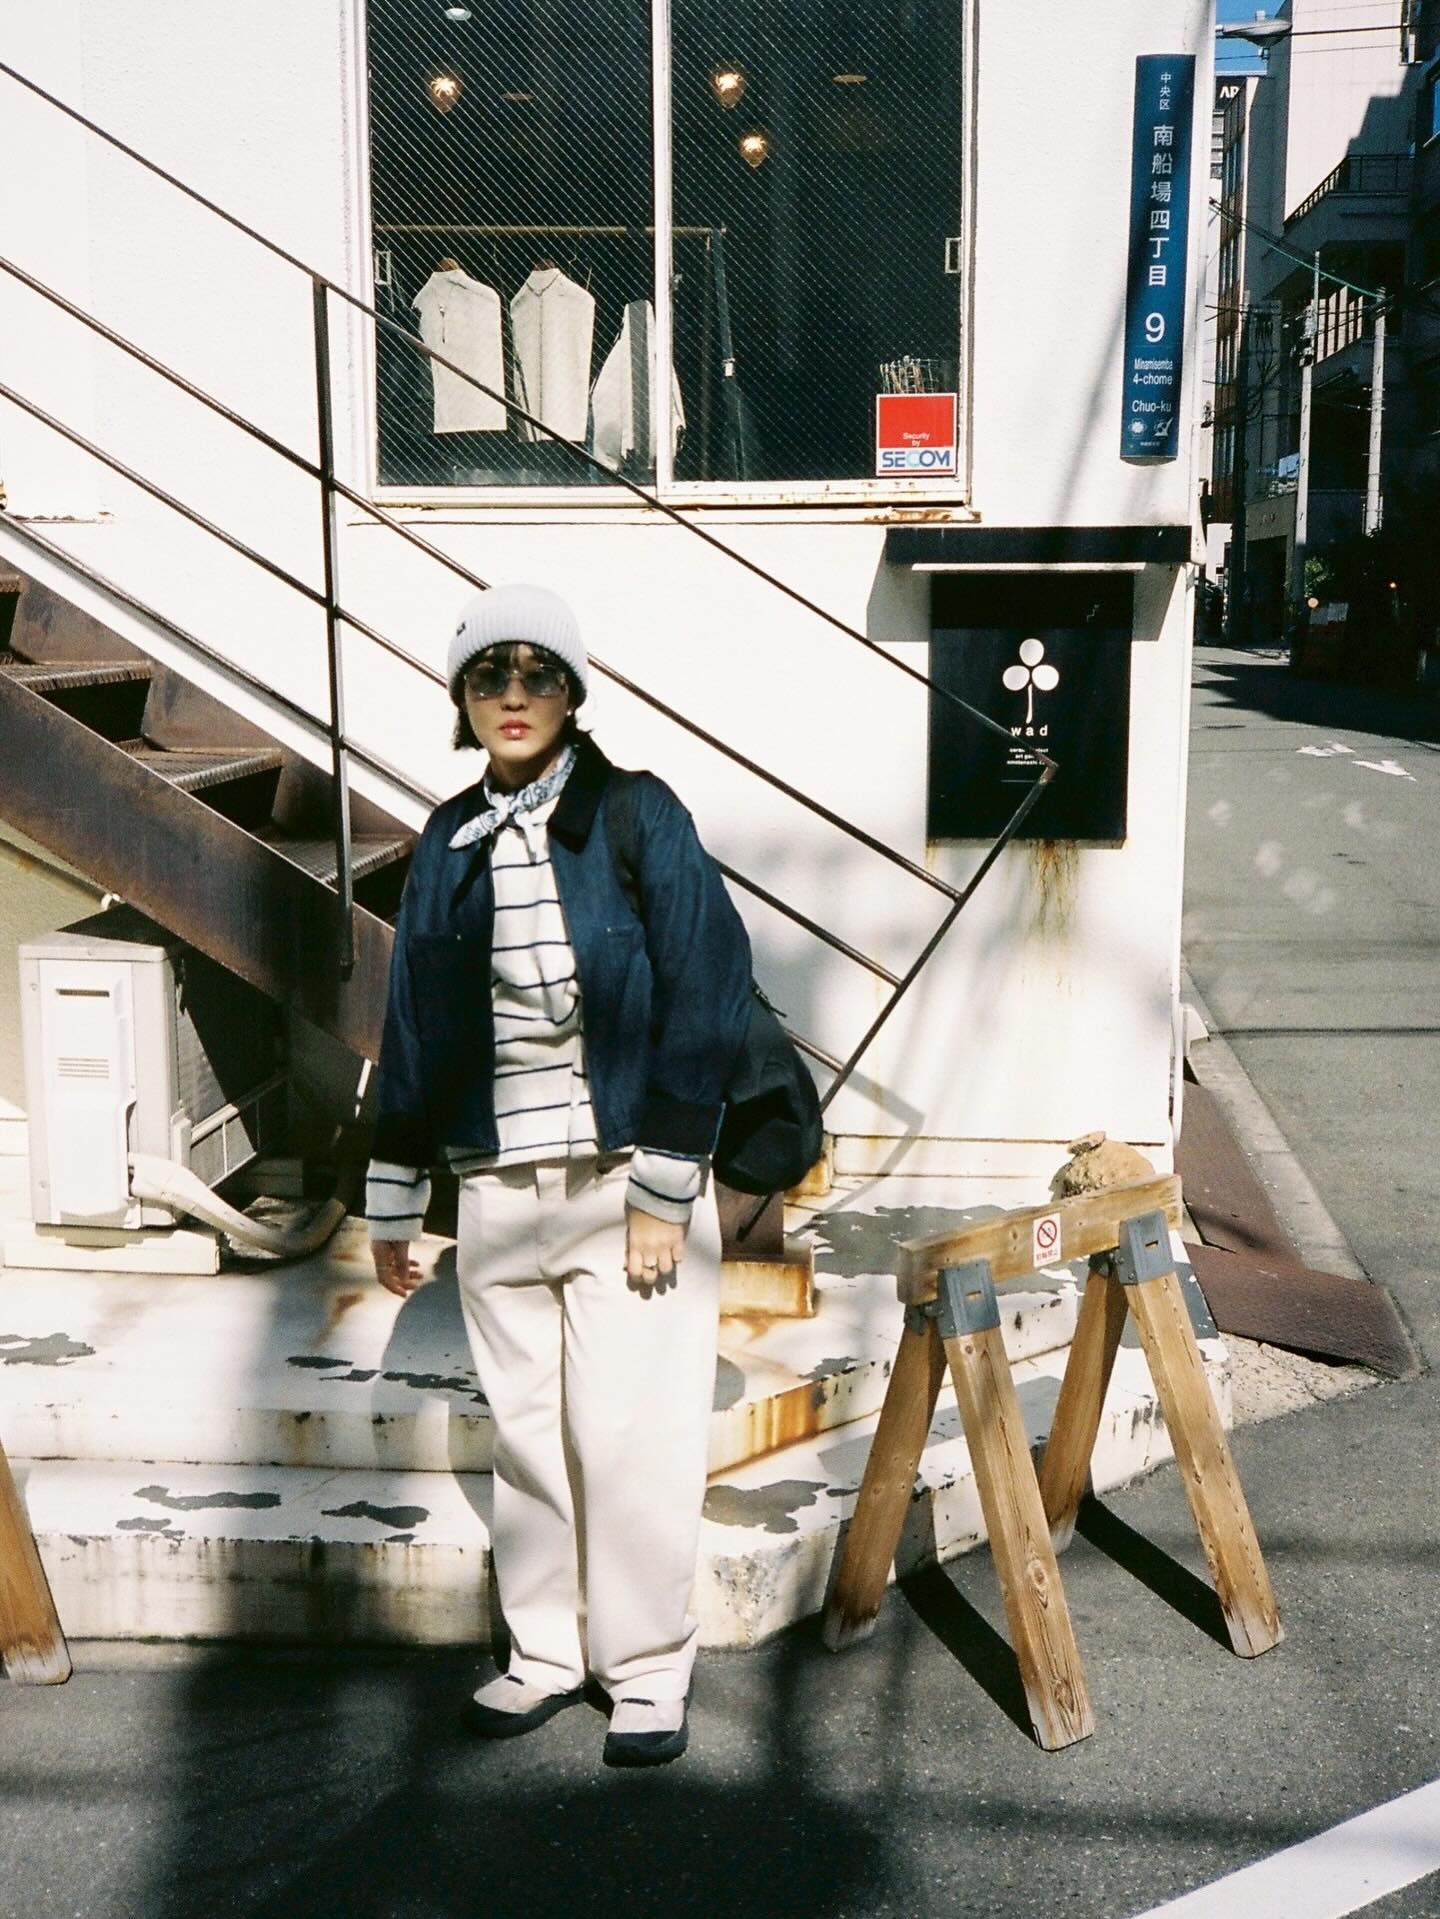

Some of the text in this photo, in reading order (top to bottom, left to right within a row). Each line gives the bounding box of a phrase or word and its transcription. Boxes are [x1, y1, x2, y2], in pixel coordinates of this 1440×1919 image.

[1159, 72, 1172, 110] 中央区
[1145, 124, 1174, 343] 南船場四丁目 9
[1134, 358, 1173, 370] Minamisemba
[1133, 373, 1173, 385] 4-chome
[1132, 400, 1172, 412] Chuo-ku
[903, 432, 930, 440] Security
[912, 440, 920, 448] by
[882, 450, 950, 467] SECOM
